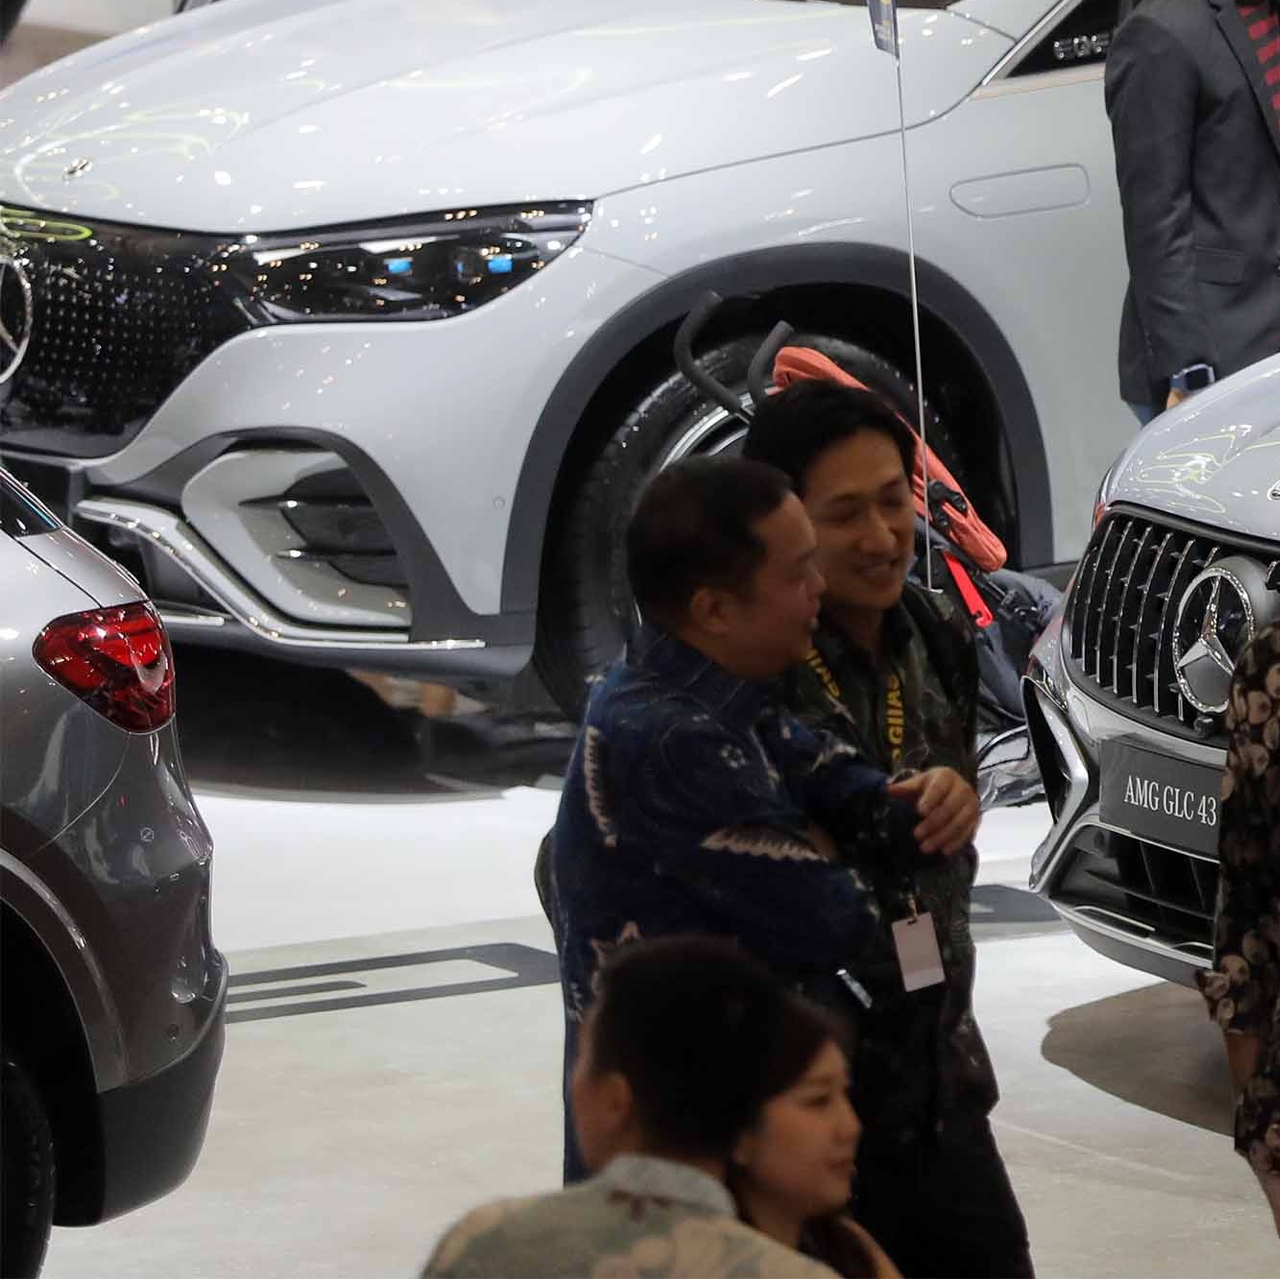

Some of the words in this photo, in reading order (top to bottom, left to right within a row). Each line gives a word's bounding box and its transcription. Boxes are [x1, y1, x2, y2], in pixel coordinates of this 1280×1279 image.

[1124, 774, 1160, 812] AMG
[1163, 785, 1195, 820] GLC
[1197, 794, 1218, 826] 43
